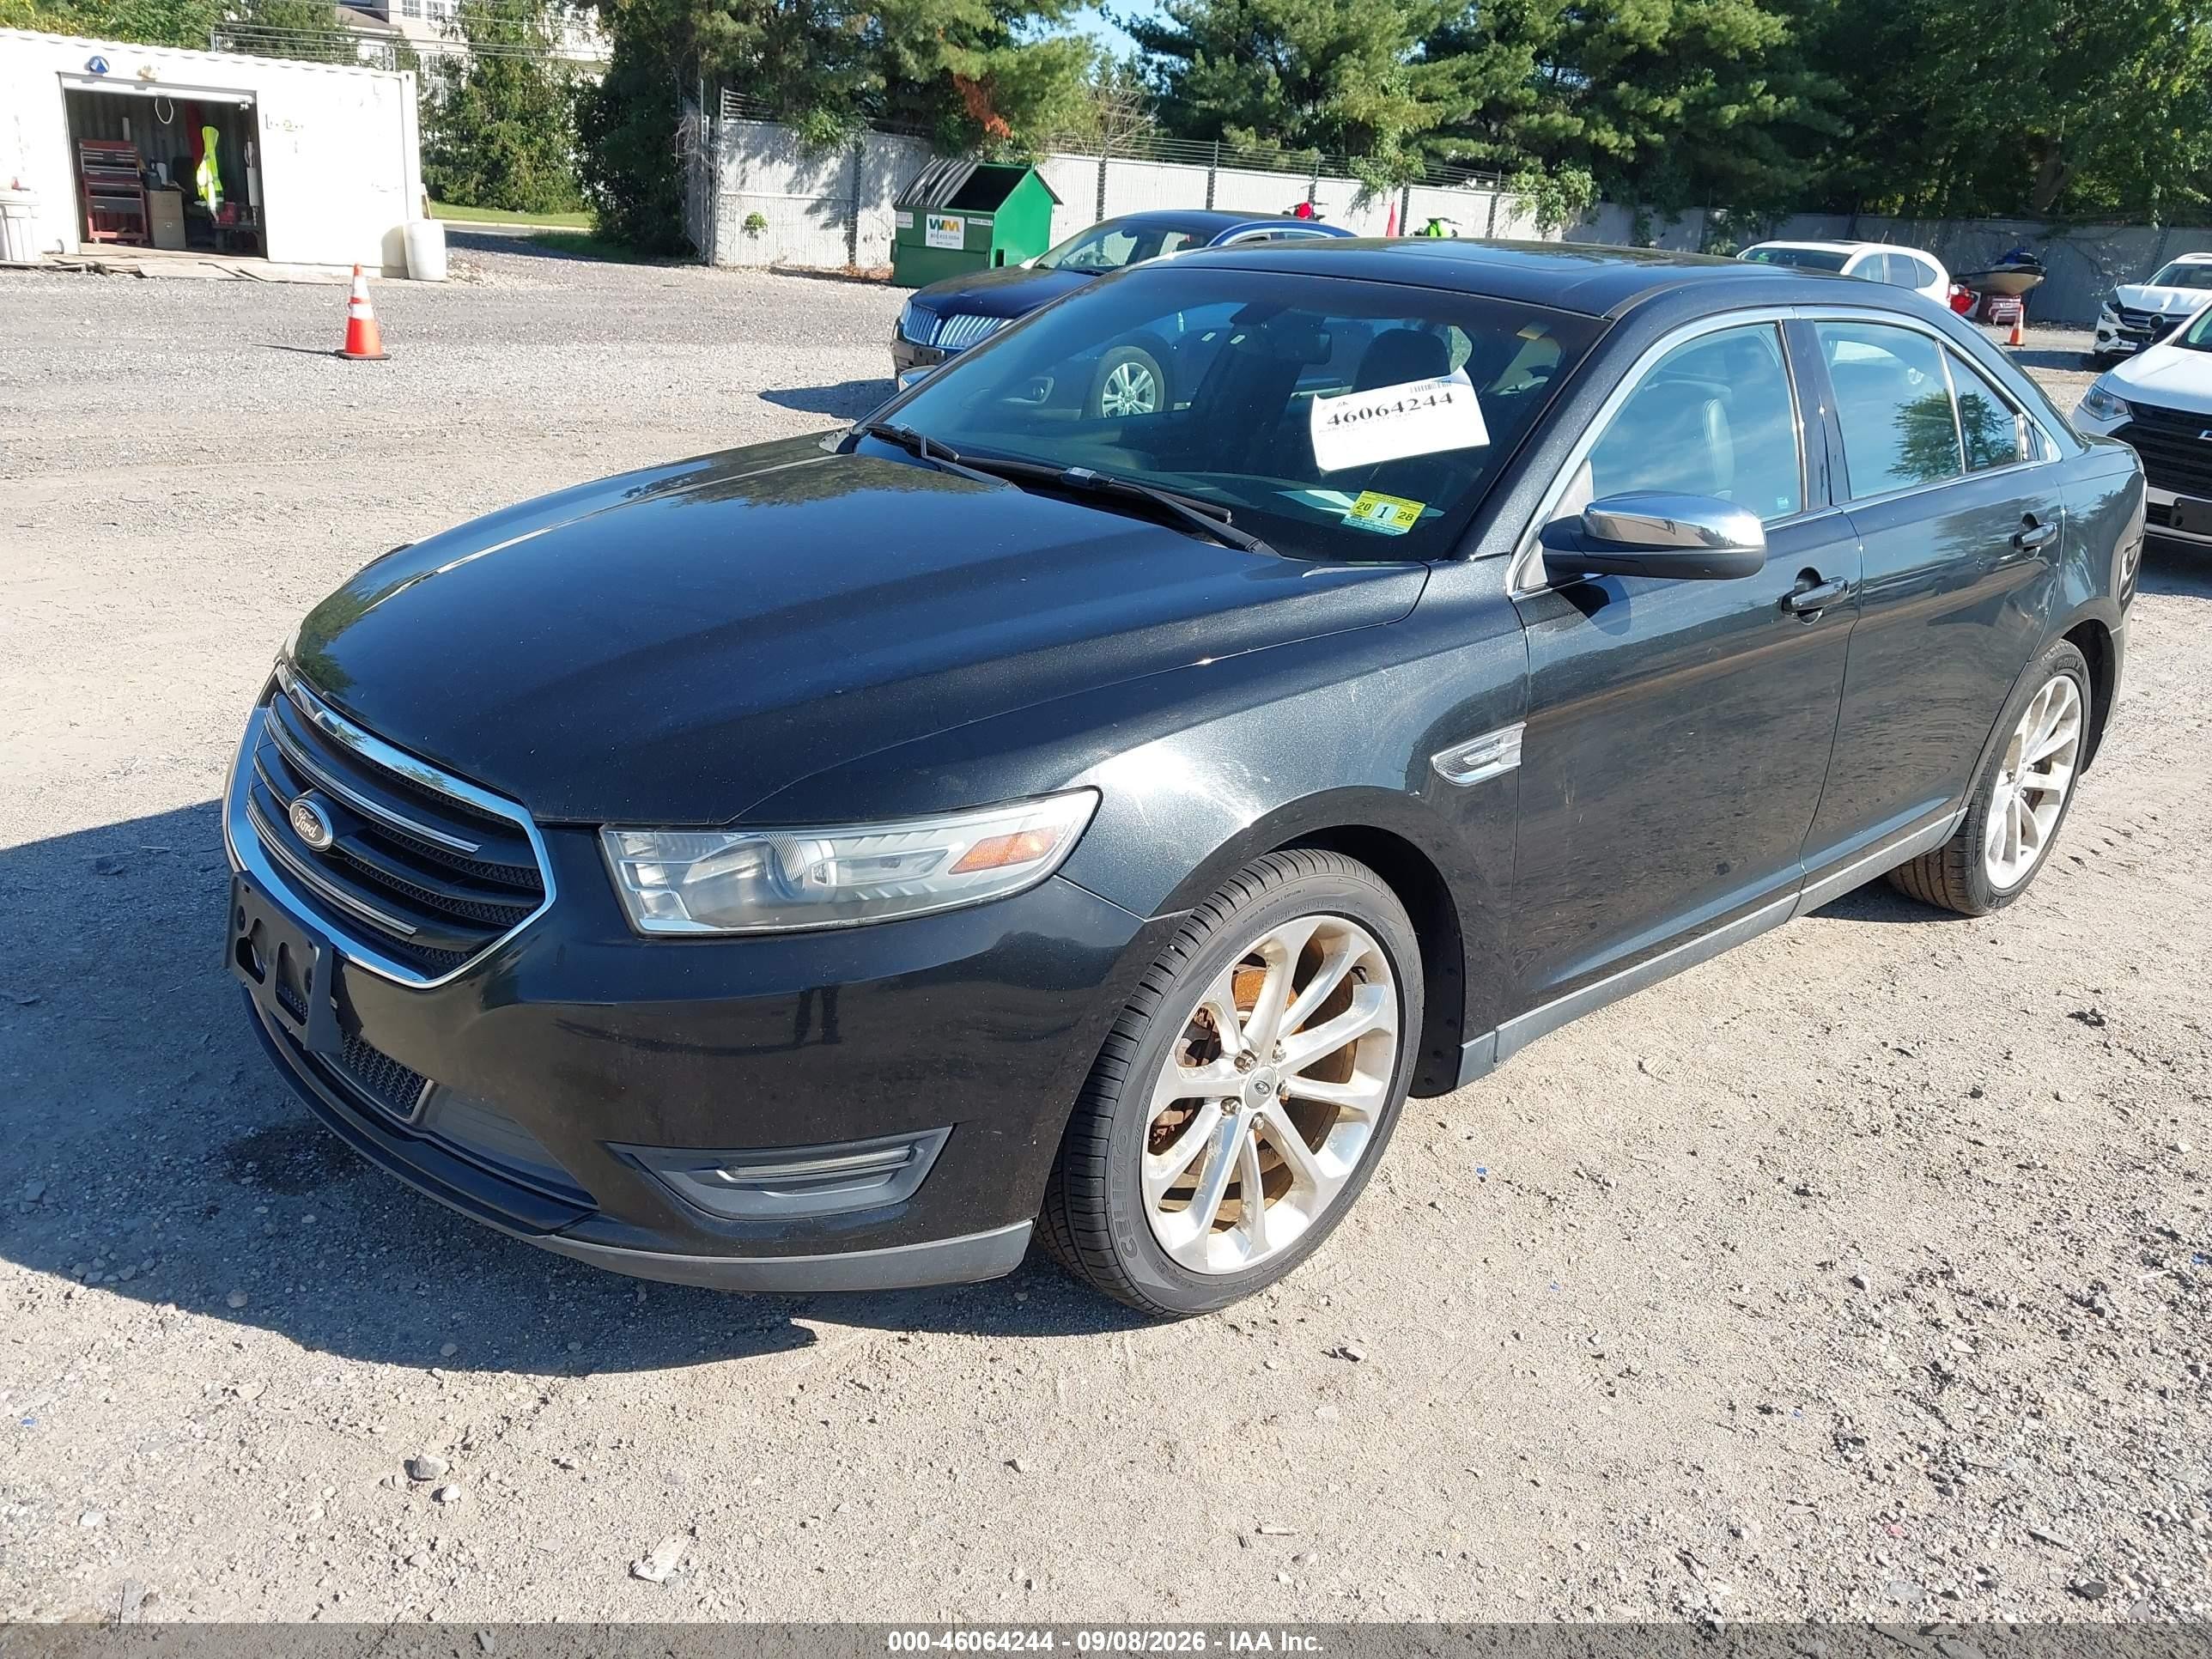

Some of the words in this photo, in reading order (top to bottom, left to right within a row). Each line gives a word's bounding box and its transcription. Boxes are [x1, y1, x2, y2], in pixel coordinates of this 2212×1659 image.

[928, 218, 960, 232] WM
[1326, 392, 1455, 426] 46064244
[1355, 501, 1372, 512] 20
[1376, 505, 1389, 519] 1
[1397, 511, 1414, 521] 28
[295, 807, 319, 838] Ford
